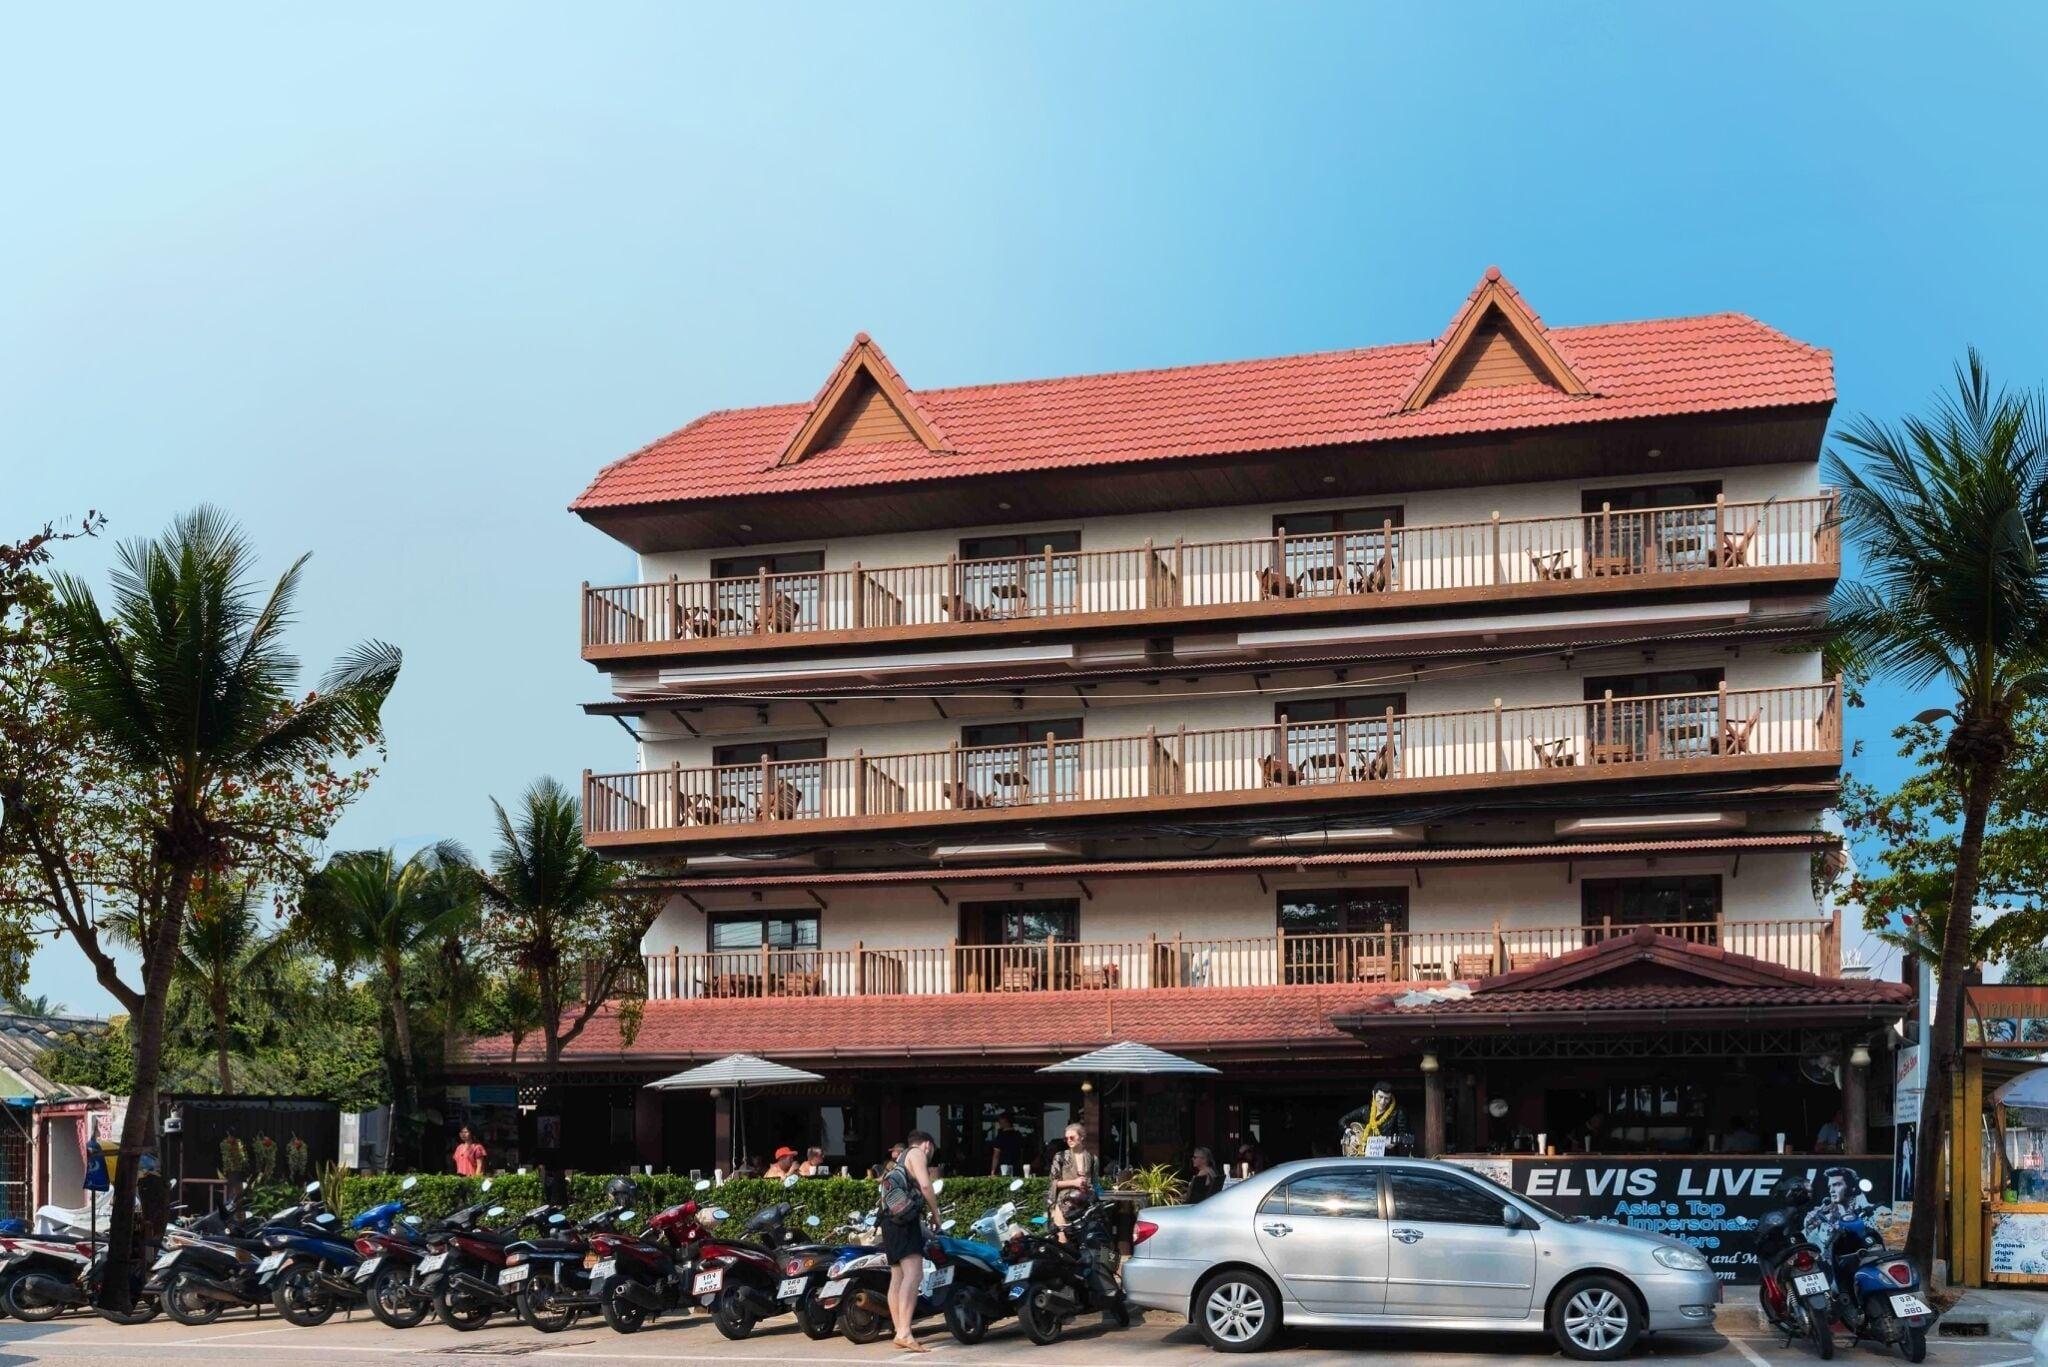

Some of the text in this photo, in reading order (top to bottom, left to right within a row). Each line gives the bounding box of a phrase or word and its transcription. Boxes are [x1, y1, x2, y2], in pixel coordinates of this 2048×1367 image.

[1525, 1168, 1658, 1196] ELVIS
[1677, 1168, 1783, 1196] LIVE
[1614, 1200, 1726, 1218] Asia's Top
[1628, 1215, 1760, 1233] Impersonao
[1711, 1251, 1742, 1264] and
[1904, 1306, 1922, 1315] 980
